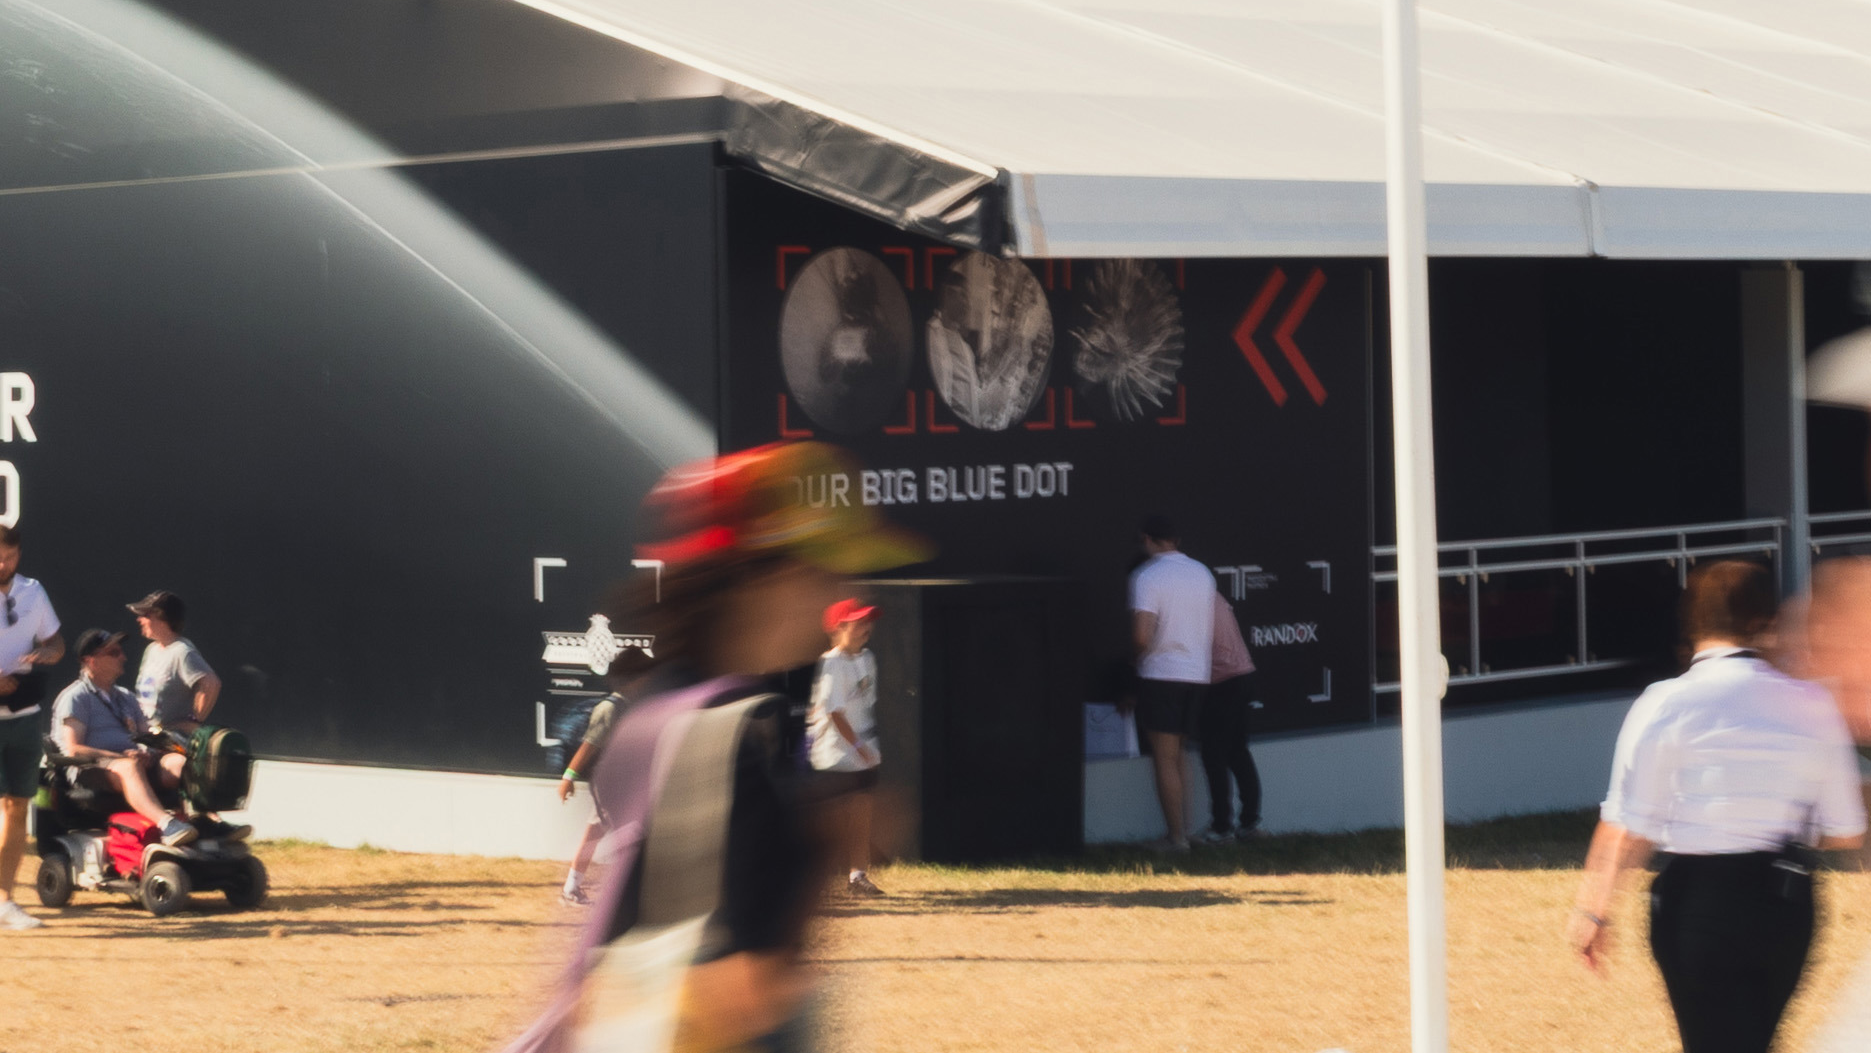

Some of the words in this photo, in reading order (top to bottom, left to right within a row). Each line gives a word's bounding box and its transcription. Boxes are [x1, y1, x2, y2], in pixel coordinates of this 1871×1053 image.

[860, 468, 919, 506] BIG
[926, 464, 1006, 502] BLUE
[1013, 461, 1074, 499] DOT
[1250, 622, 1319, 647] RANDOX
